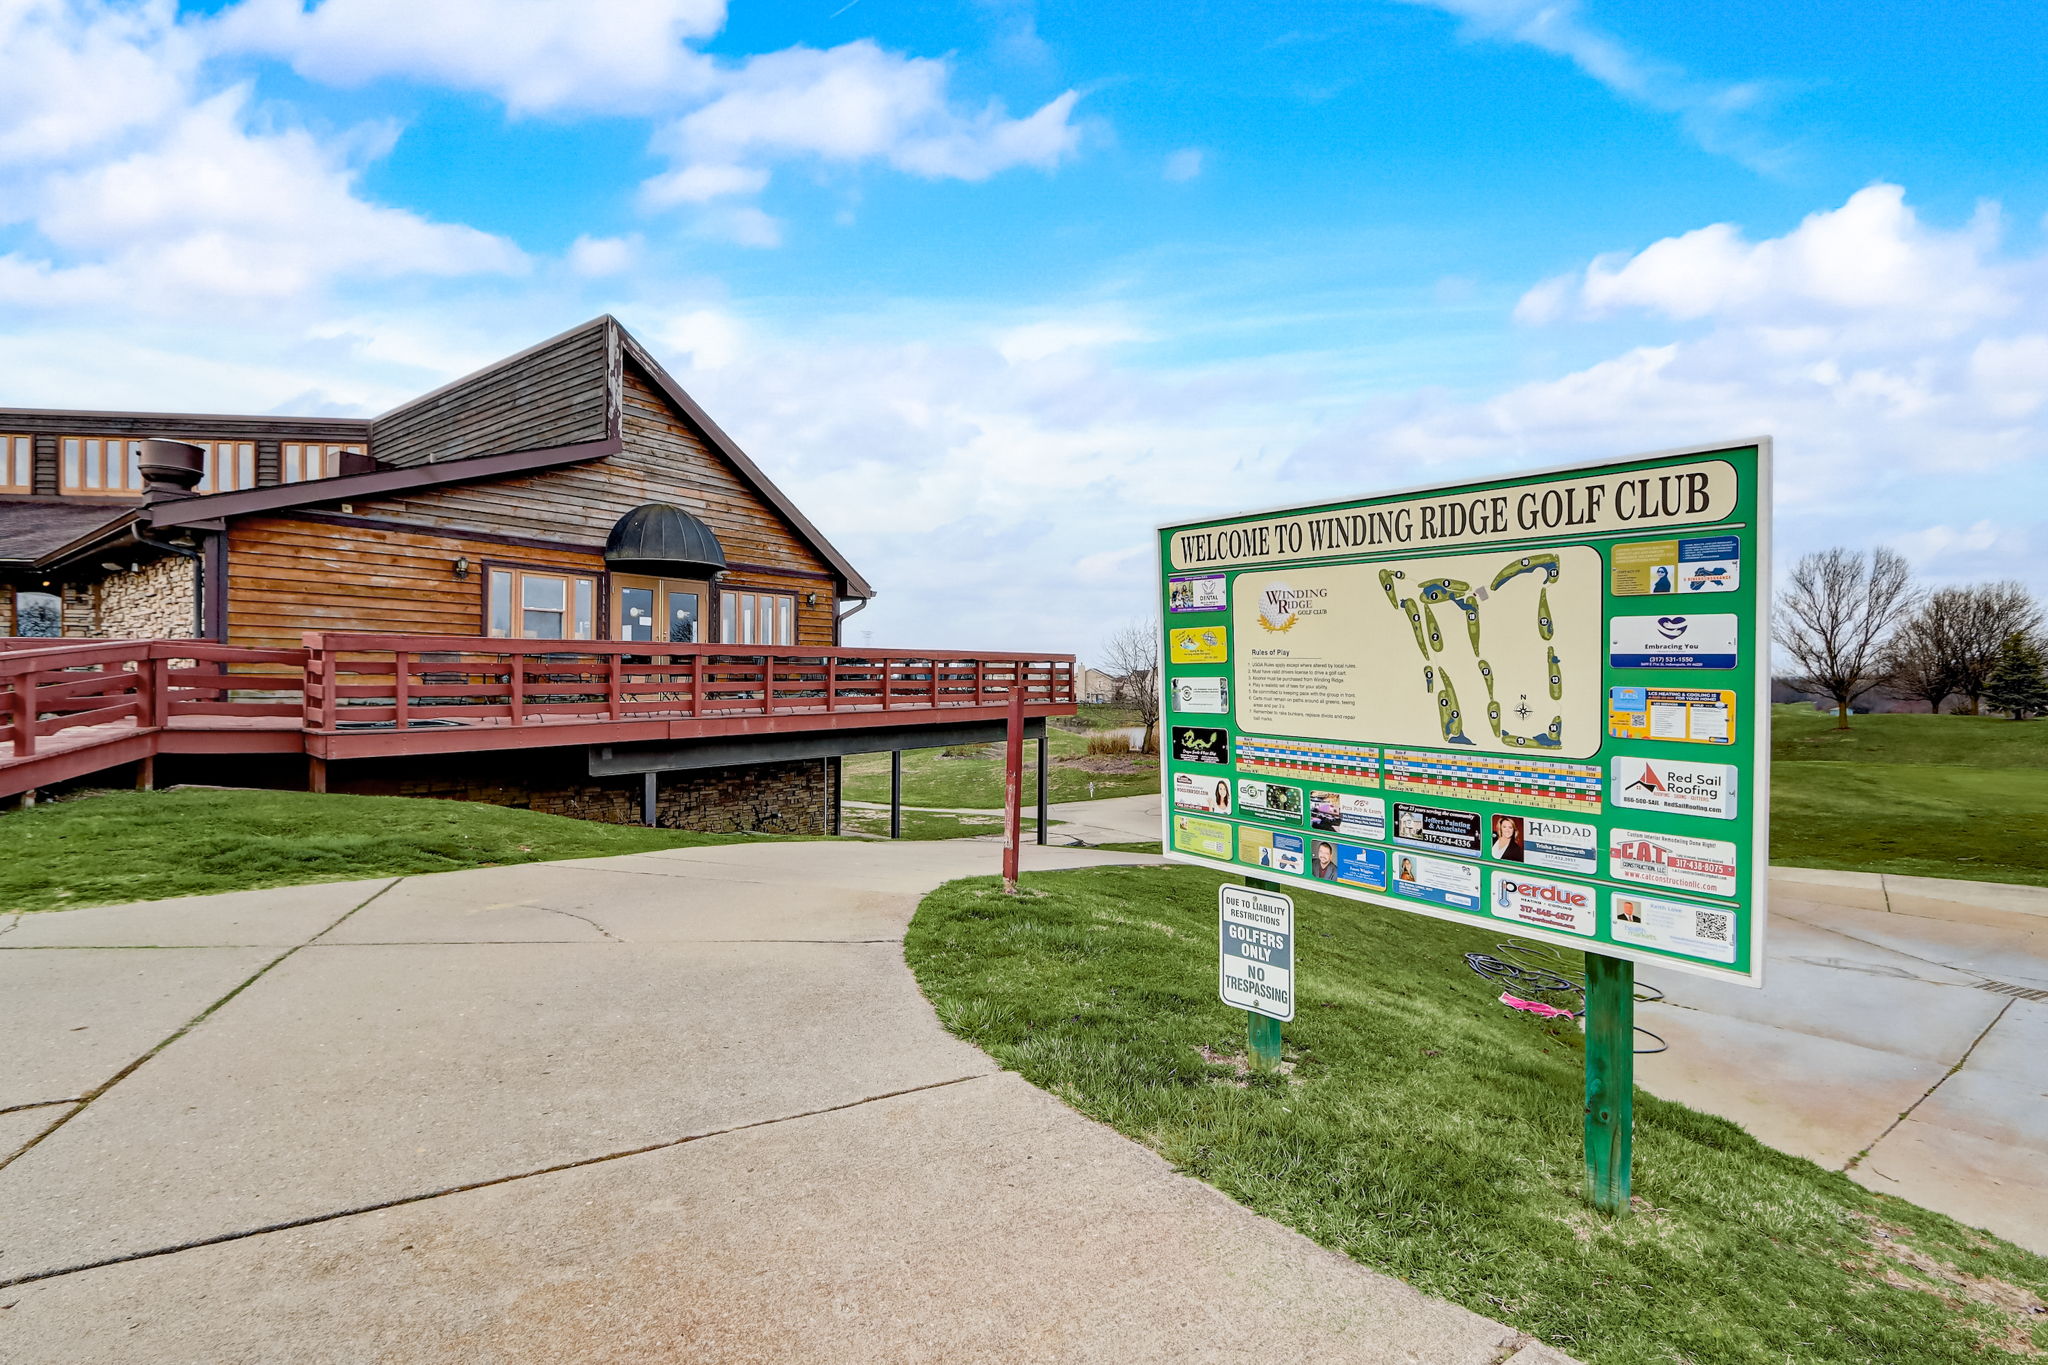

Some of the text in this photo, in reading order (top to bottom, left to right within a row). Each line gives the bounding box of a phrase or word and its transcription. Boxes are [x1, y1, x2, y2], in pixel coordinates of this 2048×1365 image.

[1181, 472, 1710, 564] WELCOME TO WINDING RIDGE GOLF CLUB
[1266, 588, 1328, 605] WINDING
[1278, 599, 1312, 614] RIDGE
[1668, 772, 1721, 786] Red Sail
[1667, 782, 1718, 800] Roofing
[1436, 825, 1466, 834] Associates
[1445, 820, 1471, 829] Painting
[1529, 821, 1591, 837] HADDAD
[1424, 834, 1471, 848] 317-294-4336
[1499, 880, 1586, 907] perdue
[1226, 897, 1285, 916] DUE TO LIABILITY
[1231, 909, 1280, 926] RESTRICTIONS
[1229, 924, 1284, 950] GOLFERS
[1241, 943, 1271, 962] ONLY
[1248, 965, 1265, 982] NO
[1226, 975, 1288, 1004] TRESPASSING
